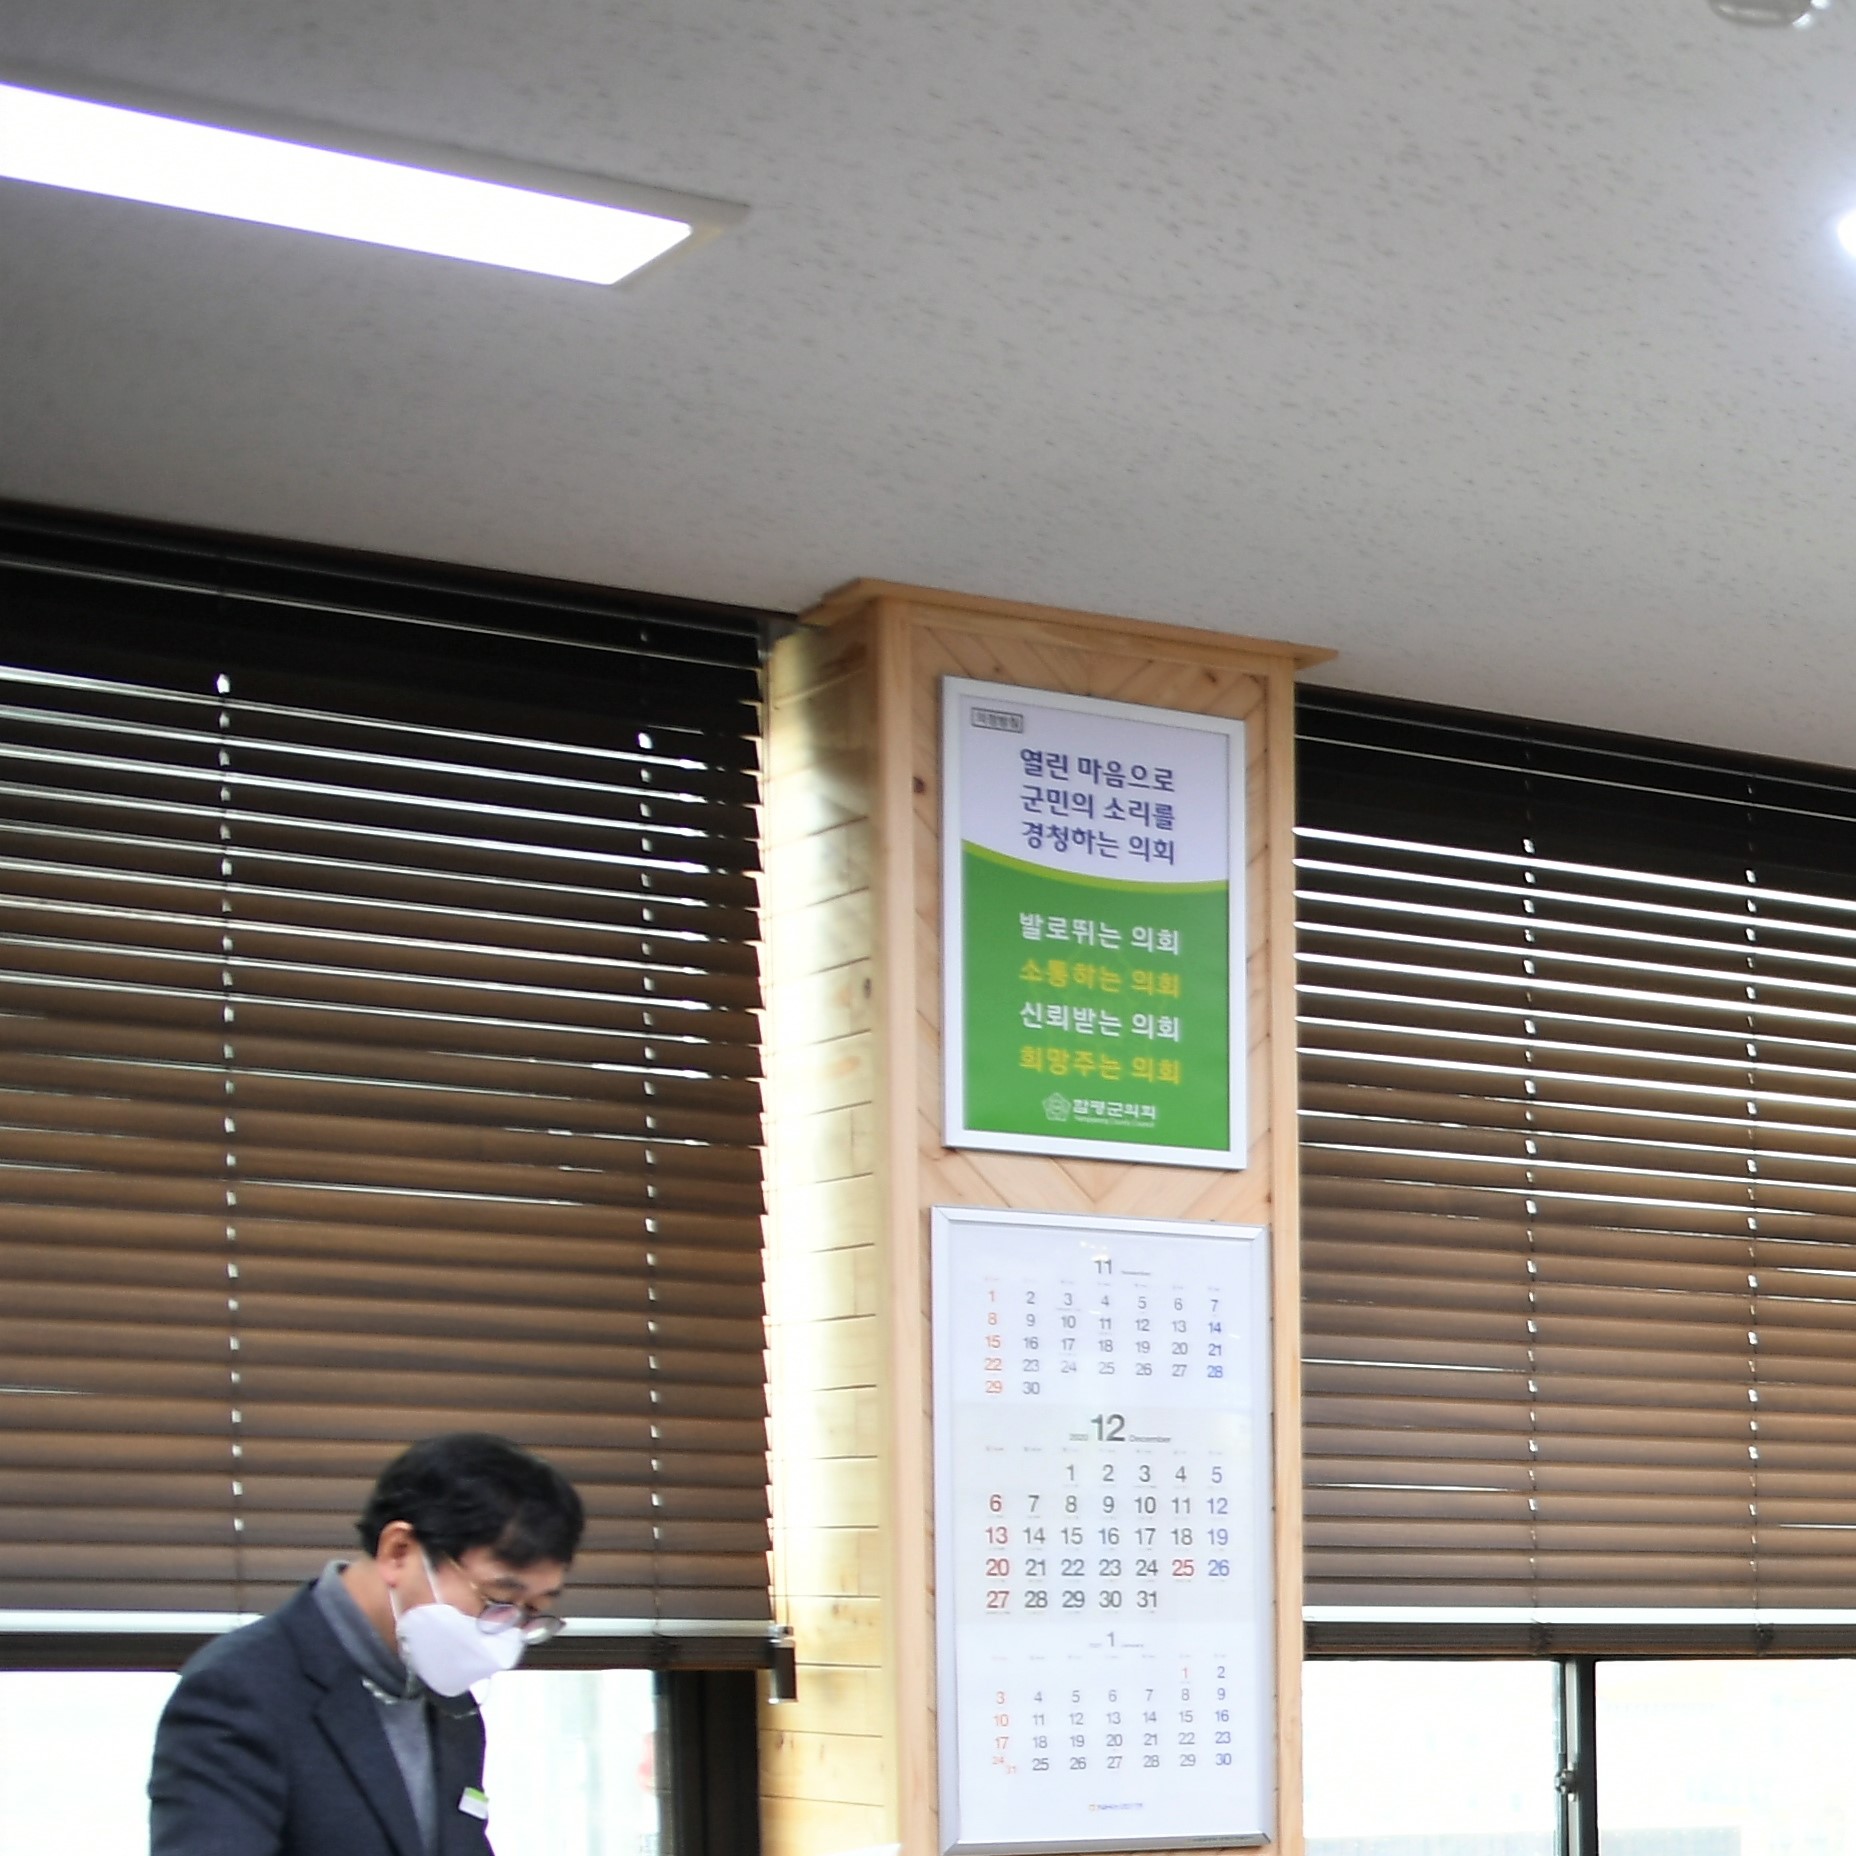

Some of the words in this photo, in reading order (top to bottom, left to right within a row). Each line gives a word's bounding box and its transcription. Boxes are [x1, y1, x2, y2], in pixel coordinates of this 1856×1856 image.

[1020, 748, 1069, 781] 열린
[1077, 756, 1175, 793] 마음으로
[1020, 784, 1094, 819] 군민의
[1103, 797, 1175, 831] 소리를
[1021, 821, 1120, 859] 경청하는
[1128, 835, 1174, 865] 의회
[1019, 912, 1122, 949] 발로뛰는
[1130, 926, 1179, 955] 의회
[1019, 959, 1122, 993] 소통하는
[1131, 968, 1180, 998] 의회
[1020, 1001, 1122, 1037] 신뢰받는
[1131, 1013, 1180, 1042] 의회
[1019, 1045, 1122, 1080] 희망주는
[1131, 1056, 1180, 1084] 의회
[1093, 1259, 1112, 1275] 11
[988, 1289, 995, 1303] 1
[1026, 1290, 1036, 1305] 2
[1063, 1292, 1073, 1307] 3
[1100, 1294, 1111, 1307] 4
[1137, 1295, 1147, 1310] 5
[1173, 1297, 1184, 1312] 6
[1210, 1298, 1220, 1313] 7
[987, 1311, 998, 1326] 8
[1025, 1313, 1036, 1328] 9
[1060, 1314, 1077, 1329] 10
[1098, 1317, 1112, 1330] 11
[1135, 1318, 1151, 1332] 12
[1171, 1319, 1187, 1334] 13
[1207, 1321, 1223, 1334] 14
[985, 1334, 1001, 1349] 15
[1022, 1336, 1040, 1351] 16
[1060, 1337, 1076, 1351] 17
[1097, 1338, 1114, 1353] 18
[1135, 1340, 1151, 1354] 19
[1171, 1341, 1189, 1356] 20
[1208, 1342, 1222, 1357] 21
[984, 1357, 1003, 1372] 22
[1022, 1358, 1040, 1373] 23
[1060, 1359, 1078, 1374] 24
[1098, 1361, 1116, 1376] 25
[1135, 1362, 1153, 1377] 26
[1171, 1363, 1188, 1378] 27
[1206, 1364, 1224, 1379] 28
[985, 1380, 1003, 1394] 29
[1022, 1380, 1041, 1396] 30
[1090, 1413, 1126, 1442] 12
[1066, 1463, 1075, 1482] 1
[1102, 1463, 1115, 1483] 2
[1138, 1464, 1152, 1483] 3
[1174, 1465, 1187, 1483] 4
[1211, 1465, 1223, 1484] 5
[989, 1493, 1003, 1513] 6
[1027, 1494, 1041, 1513] 7
[1064, 1494, 1078, 1514] 8
[1102, 1495, 1115, 1514] 9
[1134, 1496, 1157, 1514] 10
[1171, 1496, 1191, 1515] 11
[1206, 1497, 1229, 1515] 12
[985, 1526, 1009, 1545] 13
[1022, 1526, 1046, 1545] 14
[1060, 1526, 1084, 1545] 15
[1097, 1527, 1120, 1546] 16
[1134, 1527, 1157, 1546] 17
[1170, 1527, 1193, 1546] 18
[1207, 1527, 1229, 1546] 19
[985, 1558, 1010, 1577] 20
[1025, 1558, 1046, 1577] 21
[1060, 1558, 1086, 1577] 22
[1098, 1558, 1122, 1577] 23
[1135, 1558, 1159, 1577] 24
[1171, 1558, 1195, 1577] 25
[1207, 1558, 1230, 1577] 26
[986, 1590, 1010, 1609] 27
[1024, 1590, 1049, 1609] 28
[1061, 1590, 1086, 1609] 29
[1098, 1590, 1123, 1609] 30
[1136, 1590, 1157, 1609] 31
[1106, 1631, 1115, 1647] 1
[1182, 1666, 1188, 1680] 1
[1216, 1665, 1226, 1679] 2
[996, 1690, 1006, 1705] 3
[1033, 1690, 1043, 1703] 4
[1071, 1689, 1081, 1704] 5
[1107, 1688, 1118, 1703] 6
[1144, 1688, 1154, 1702] 7
[1181, 1687, 1191, 1702] 8
[1216, 1687, 1226, 1701] 9
[993, 1713, 1010, 1727] 10
[1032, 1713, 1045, 1727] 11
[1068, 1711, 1084, 1726] 12
[1106, 1711, 1122, 1725] 13
[1142, 1710, 1158, 1724] 14
[1178, 1709, 1194, 1724] 15
[1214, 1708, 1230, 1723] 16
[994, 1736, 1010, 1750] 17
[1032, 1735, 1048, 1749] 18
[1069, 1734, 1086, 1748] 19
[1105, 1733, 1124, 1747] 20
[1143, 1732, 1158, 1747] 21
[1178, 1731, 1196, 1746] 22
[1214, 1730, 1232, 1745] 23
[1031, 1757, 1050, 1772] 25
[1069, 1756, 1087, 1771] 26
[1106, 1755, 1123, 1770] 27
[1143, 1754, 1161, 1769] 28
[1179, 1753, 1197, 1768] 29
[1215, 1752, 1233, 1767] 30
